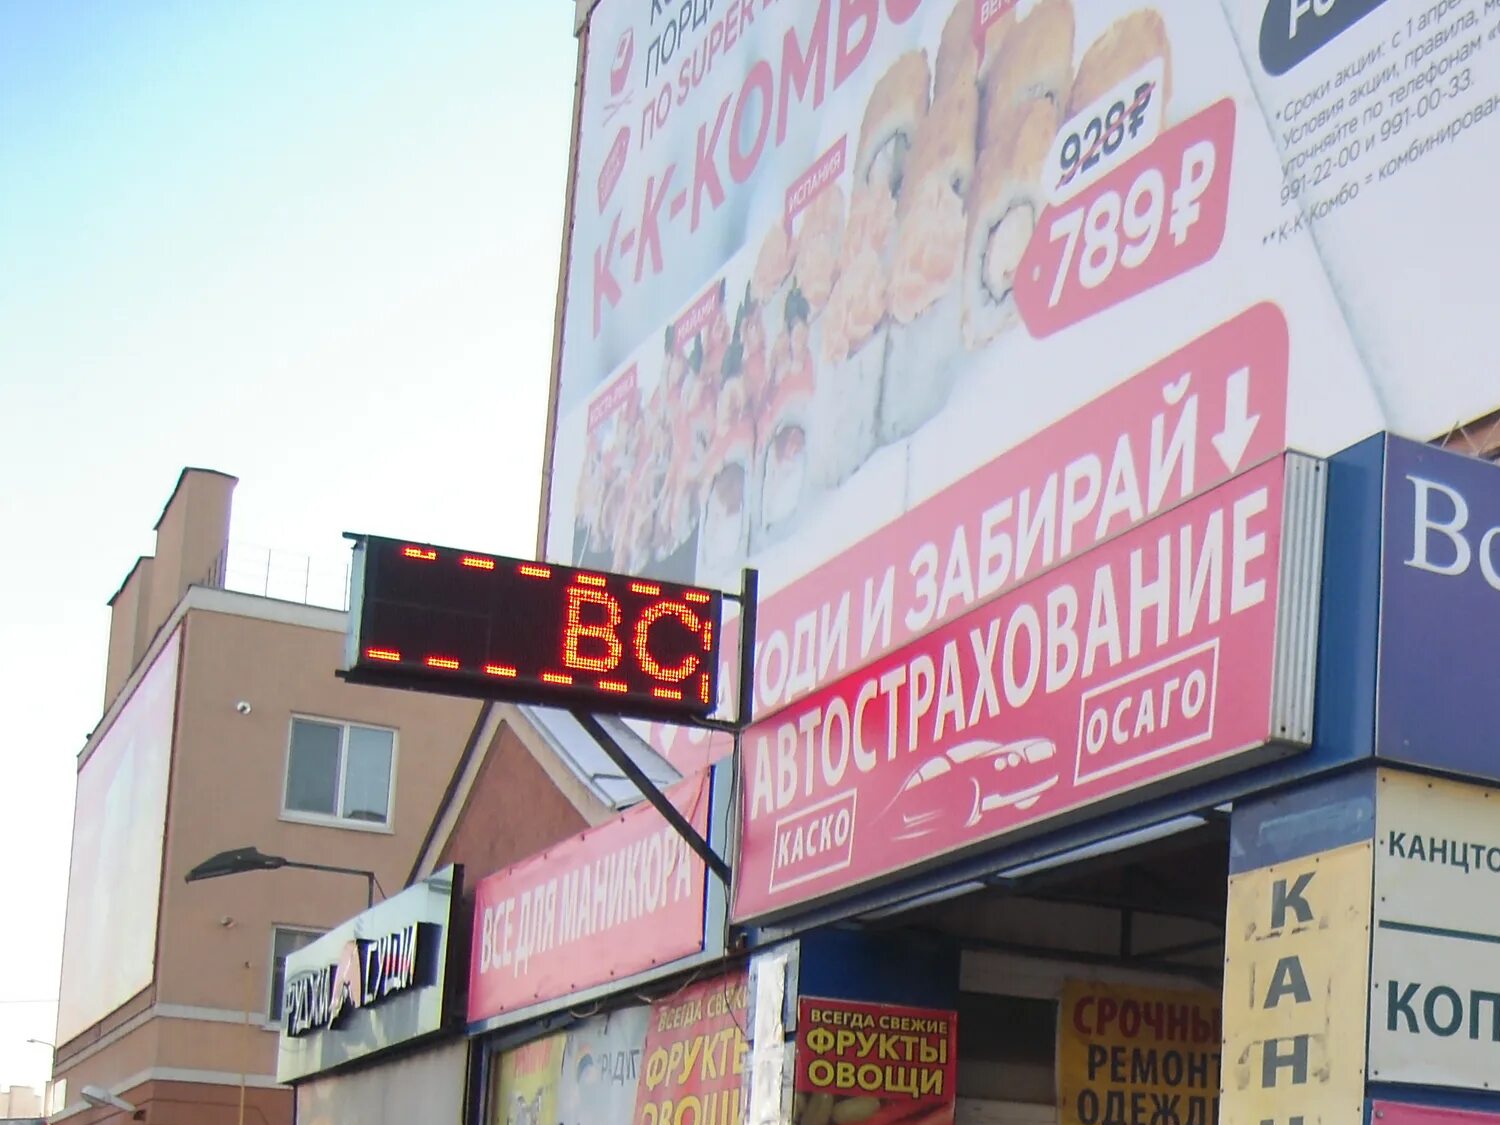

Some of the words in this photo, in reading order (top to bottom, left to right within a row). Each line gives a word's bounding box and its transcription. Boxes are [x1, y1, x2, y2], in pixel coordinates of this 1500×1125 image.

[1362, 101, 1382, 126] по
[1388, 35, 1482, 103] телефонам
[593, 0, 924, 340] К-К-КОМБ
[863, 565, 895, 637] И
[905, 372, 1200, 632] ЗАБИРАЙ
[750, 487, 1270, 820] АВТОСТРАХОВАНИЕ
[777, 808, 850, 869] КАСКО
[1084, 665, 1208, 750] ОСАГО
[480, 899, 513, 975] ВСЕ
[514, 885, 557, 979] ДЛЯ
[557, 832, 693, 946] МАНИКЮРА
[806, 1027, 947, 1064] ФРУКТЫ
[808, 1059, 944, 1099] ОВОЩИ
[811, 1008, 875, 1029] ВСЕГДА
[879, 1015, 948, 1034] СВЕЖИЕ
[1073, 995, 1222, 1045] СРОЧНЫ
